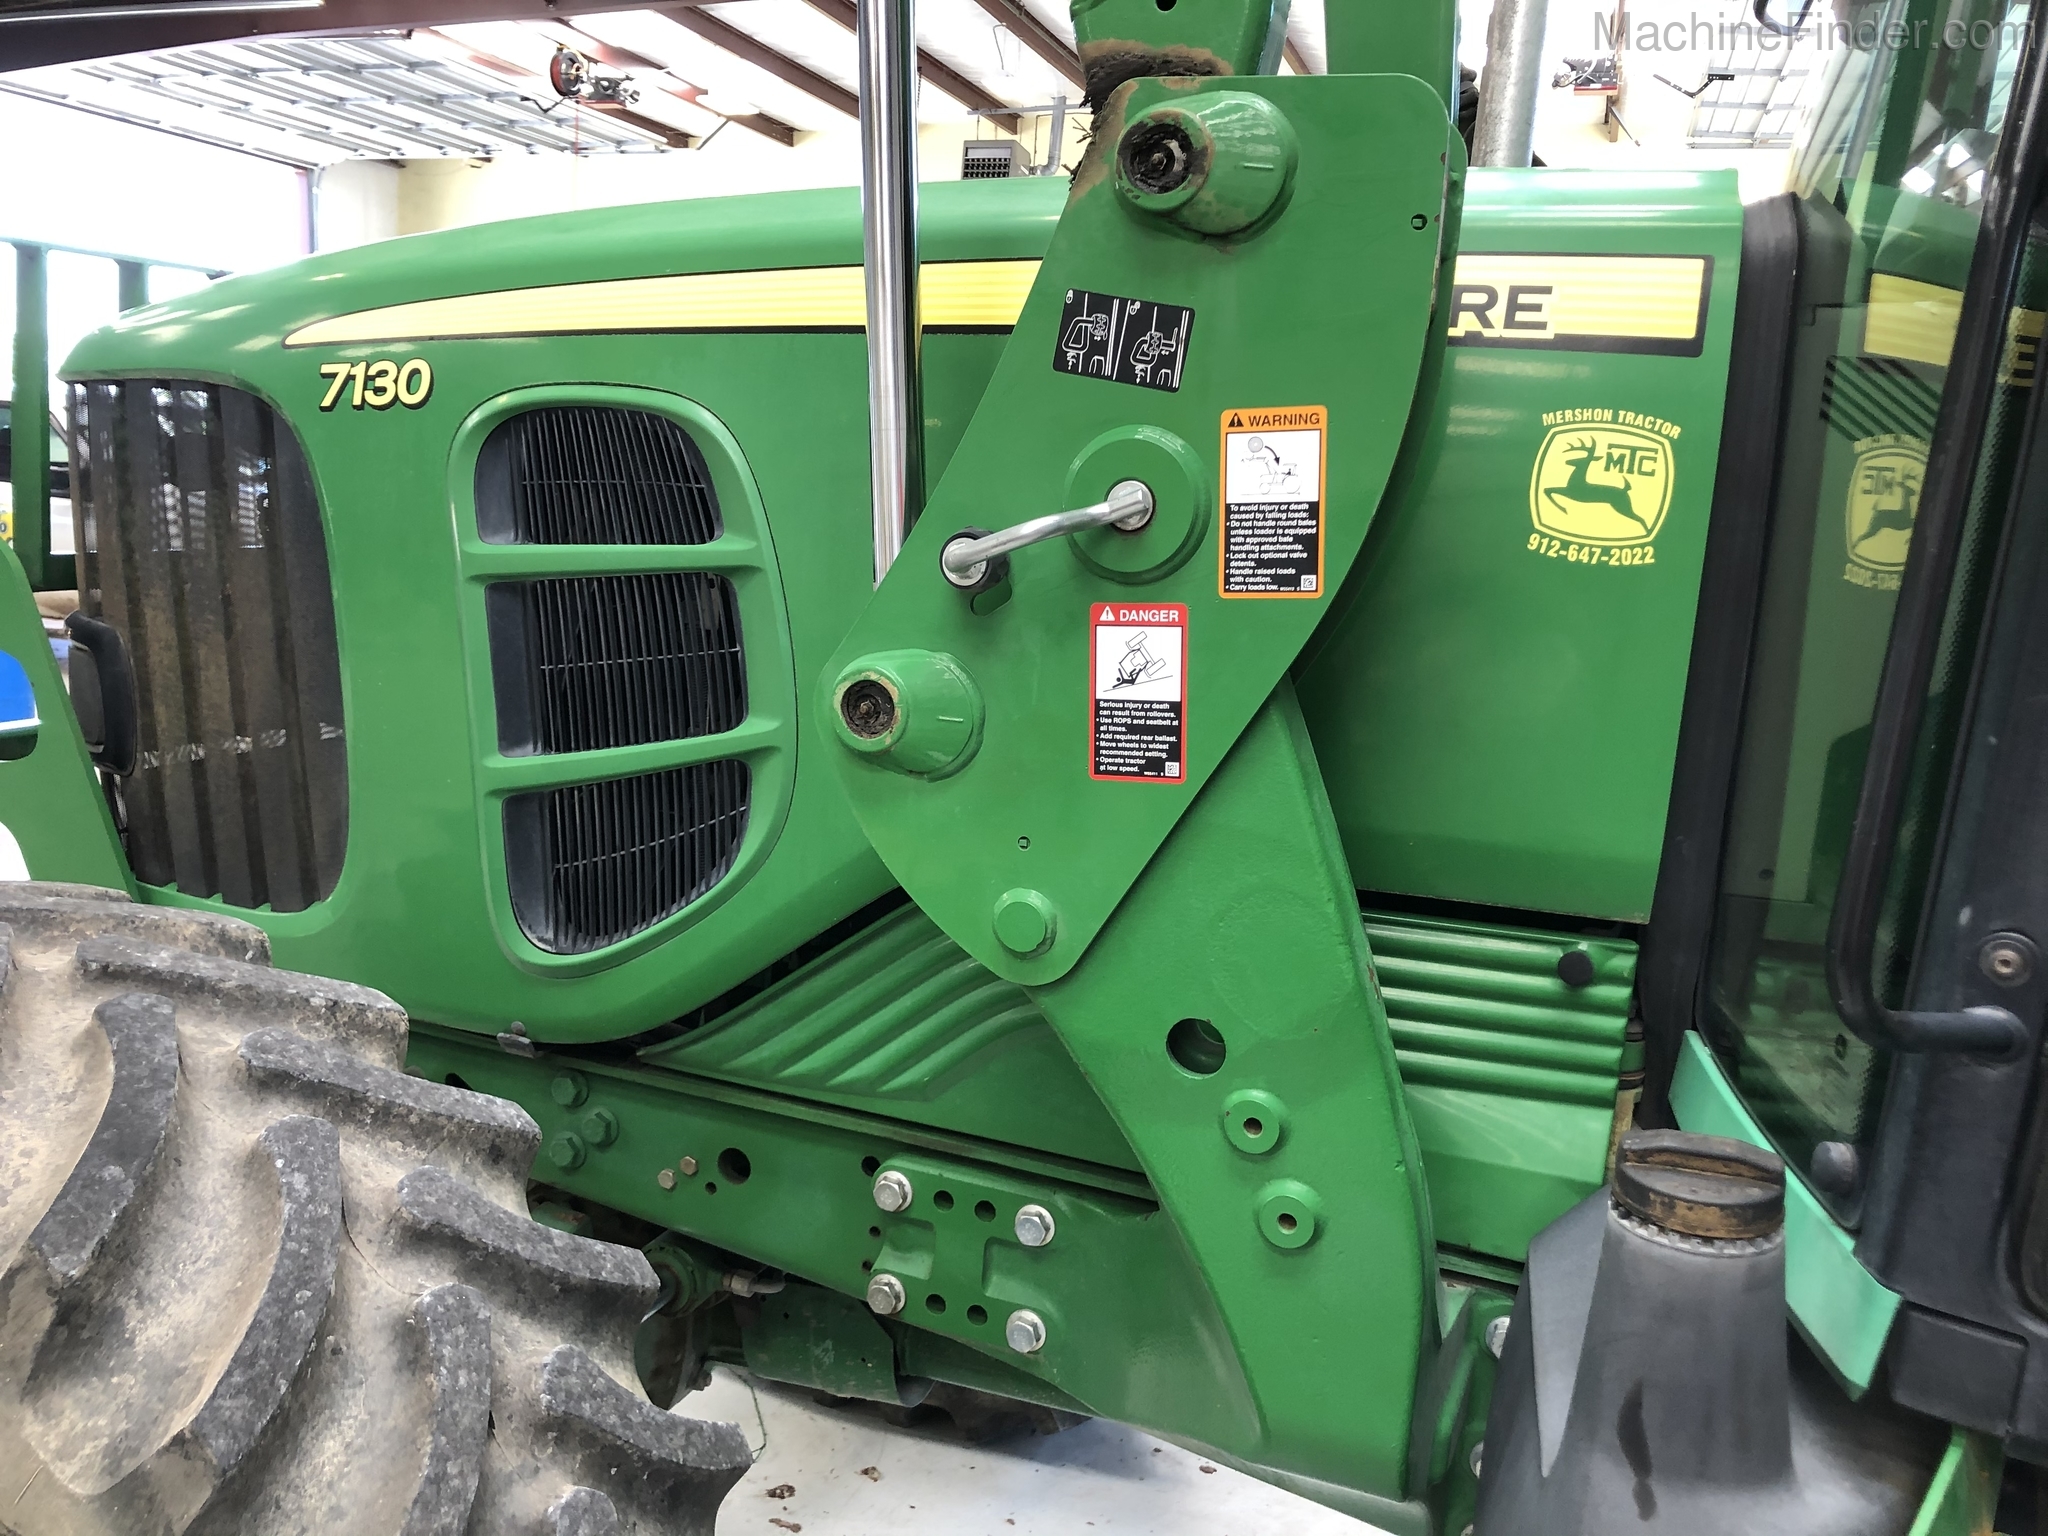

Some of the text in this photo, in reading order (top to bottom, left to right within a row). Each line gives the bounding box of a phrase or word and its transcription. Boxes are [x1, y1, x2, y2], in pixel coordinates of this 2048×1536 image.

[319, 357, 434, 412] 7130
[1248, 412, 1320, 427] WARNING
[1542, 408, 1682, 439] MERSHON TRACTOR
[1604, 443, 1659, 477] MTC
[1259, 504, 1279, 512] injury
[1284, 527, 1316, 535] equipped
[1246, 536, 1277, 544] approved
[1260, 552, 1288, 560] optional
[1527, 533, 1655, 566] 912-647-2022
[1119, 609, 1179, 623] DANGER
